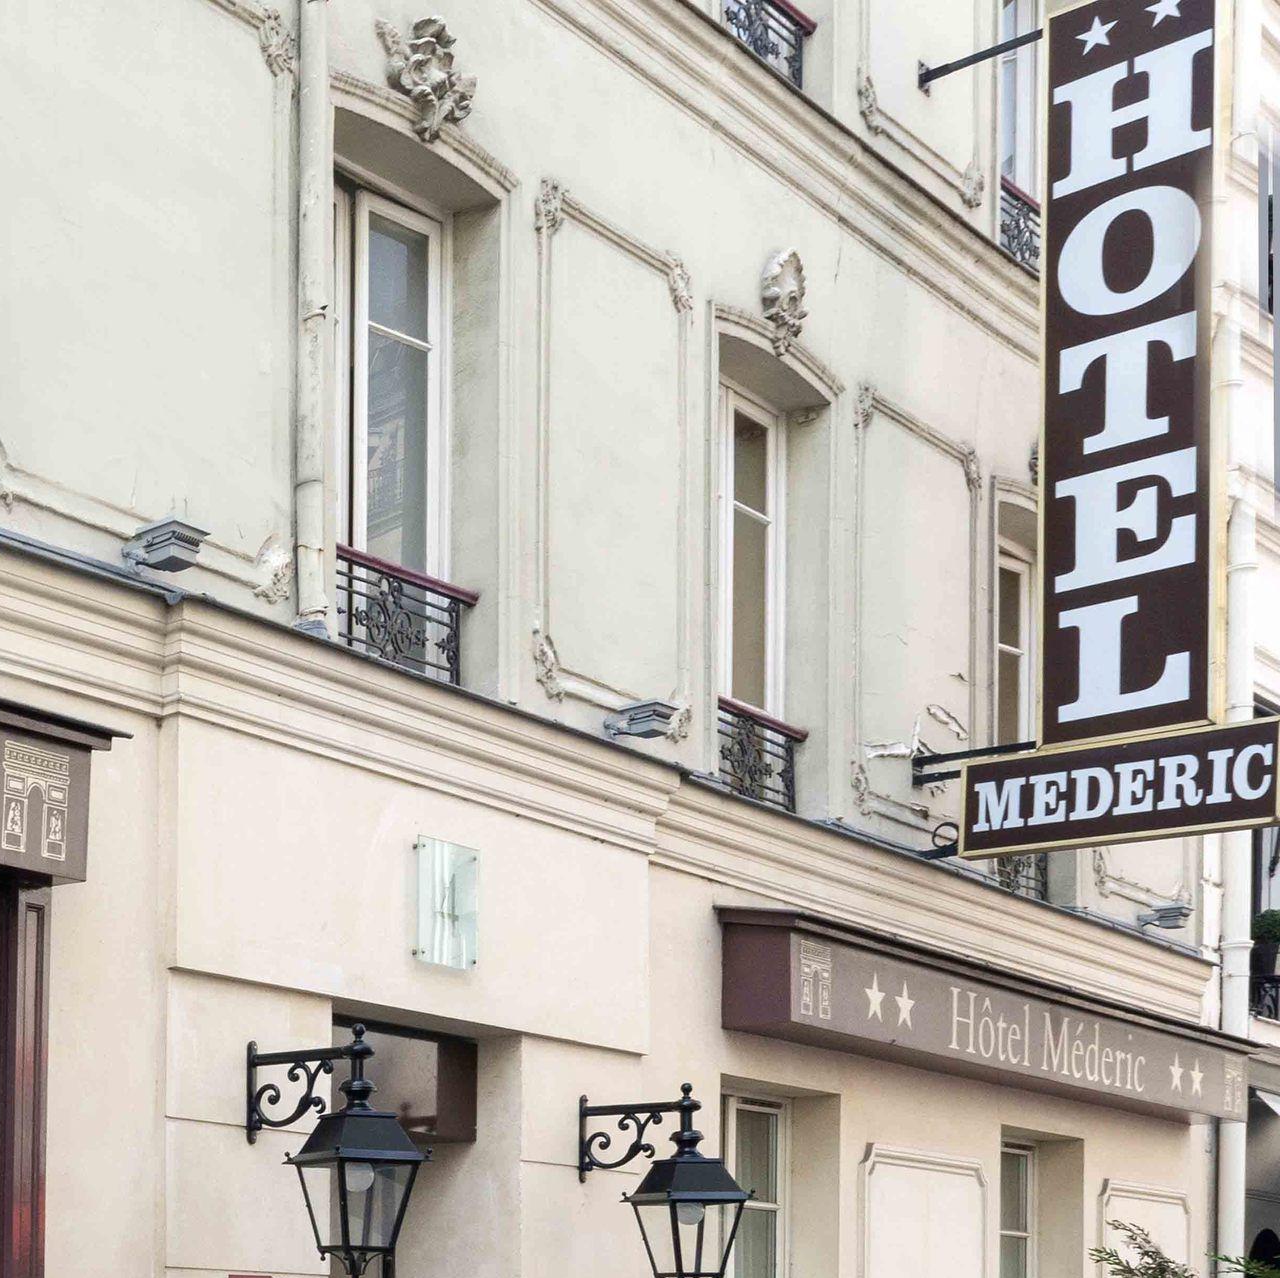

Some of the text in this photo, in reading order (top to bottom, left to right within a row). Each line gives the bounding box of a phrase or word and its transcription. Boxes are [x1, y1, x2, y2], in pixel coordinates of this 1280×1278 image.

[1052, 28, 1213, 724] HOTEL
[972, 743, 1273, 834] MEDERIC
[948, 986, 1146, 1092] Hôtel Méderic
